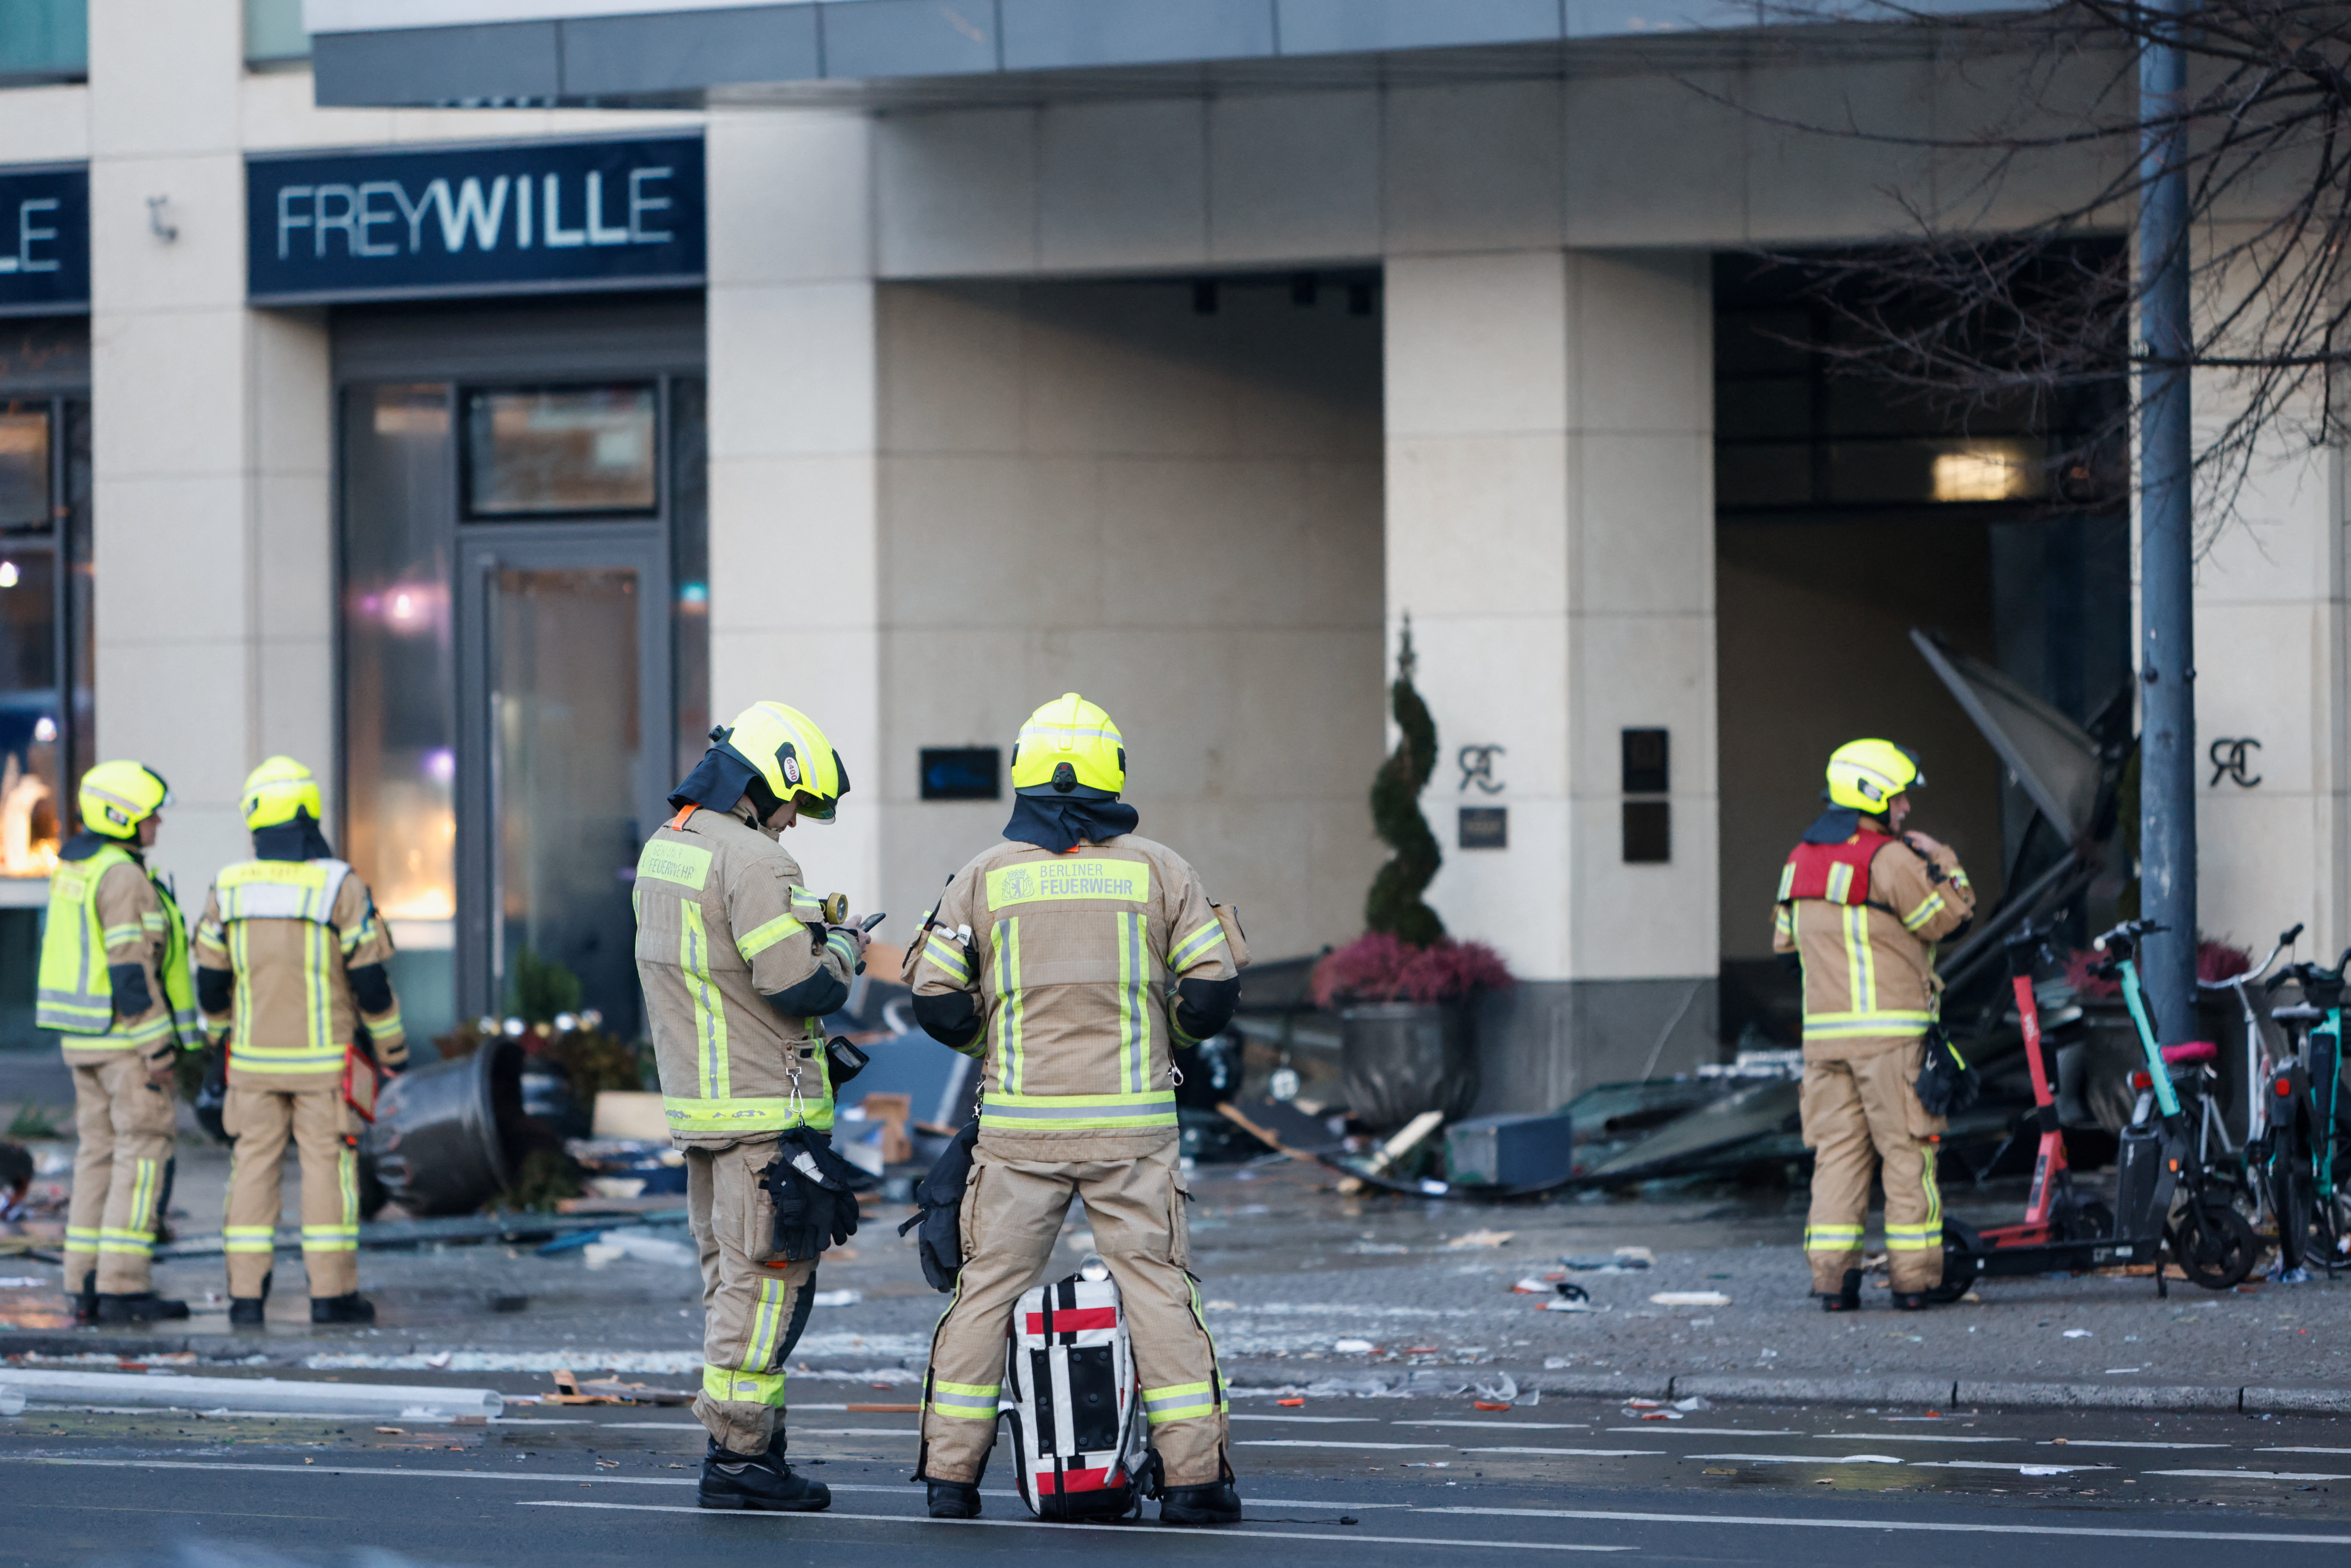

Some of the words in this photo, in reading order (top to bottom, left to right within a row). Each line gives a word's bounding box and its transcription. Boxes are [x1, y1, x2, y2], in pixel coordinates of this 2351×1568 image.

[278, 166, 674, 259] FREYWILLE
[787, 759, 797, 781] 6400
[653, 844, 683, 858] BERLINR
[648, 858, 694, 880] FEUERWEHR
[1040, 864, 1103, 878] BERLINER
[1040, 878, 1133, 896] FEUERWEHR
